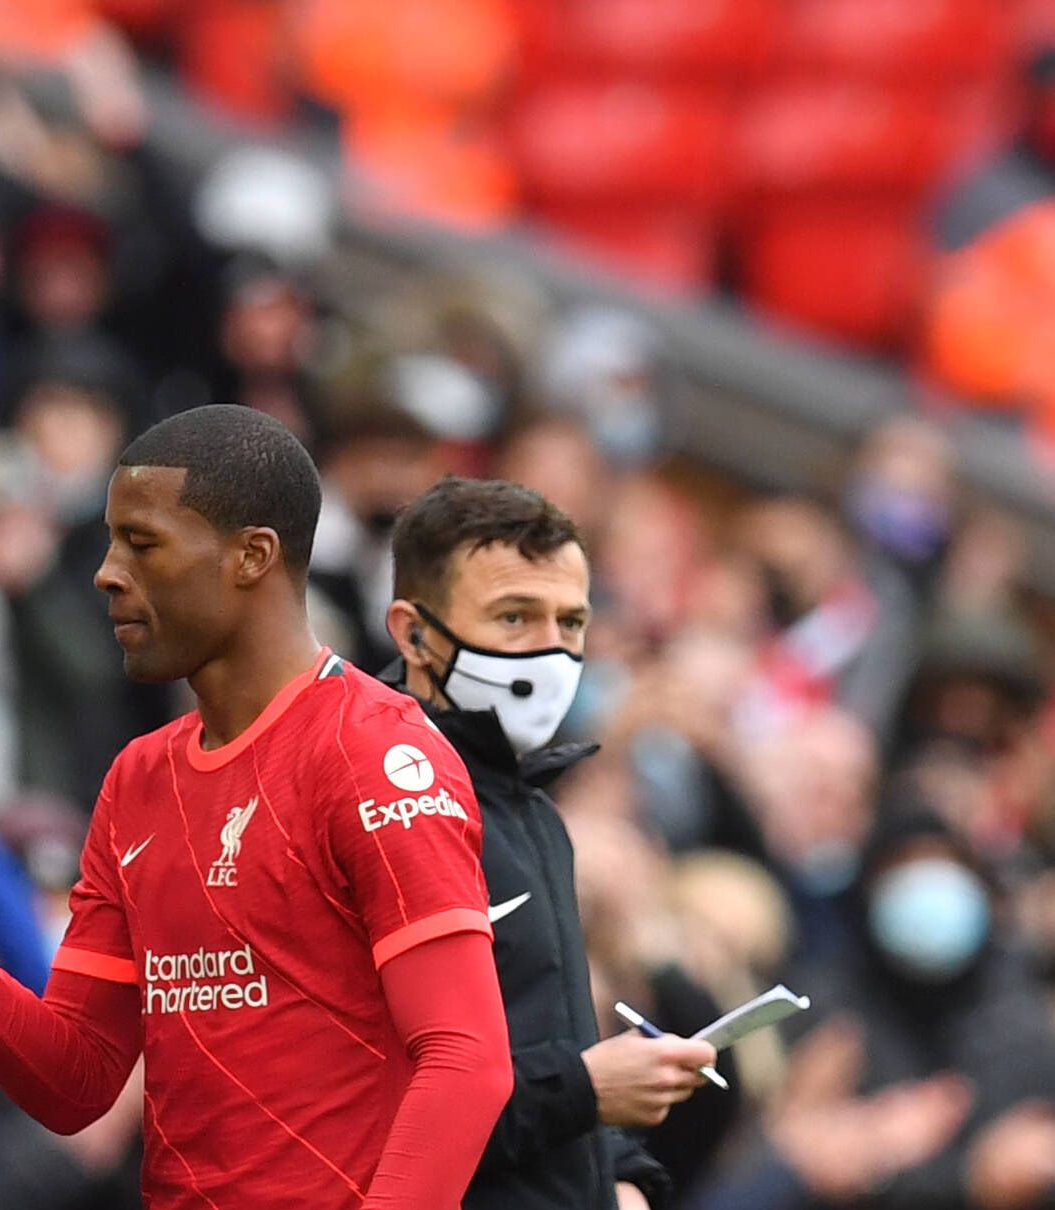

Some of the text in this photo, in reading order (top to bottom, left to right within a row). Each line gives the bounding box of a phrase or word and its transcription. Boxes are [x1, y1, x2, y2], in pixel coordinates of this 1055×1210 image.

[206, 867, 238, 887] LFC
[145, 943, 255, 981] tandard
[142, 974, 268, 1014] hartered
